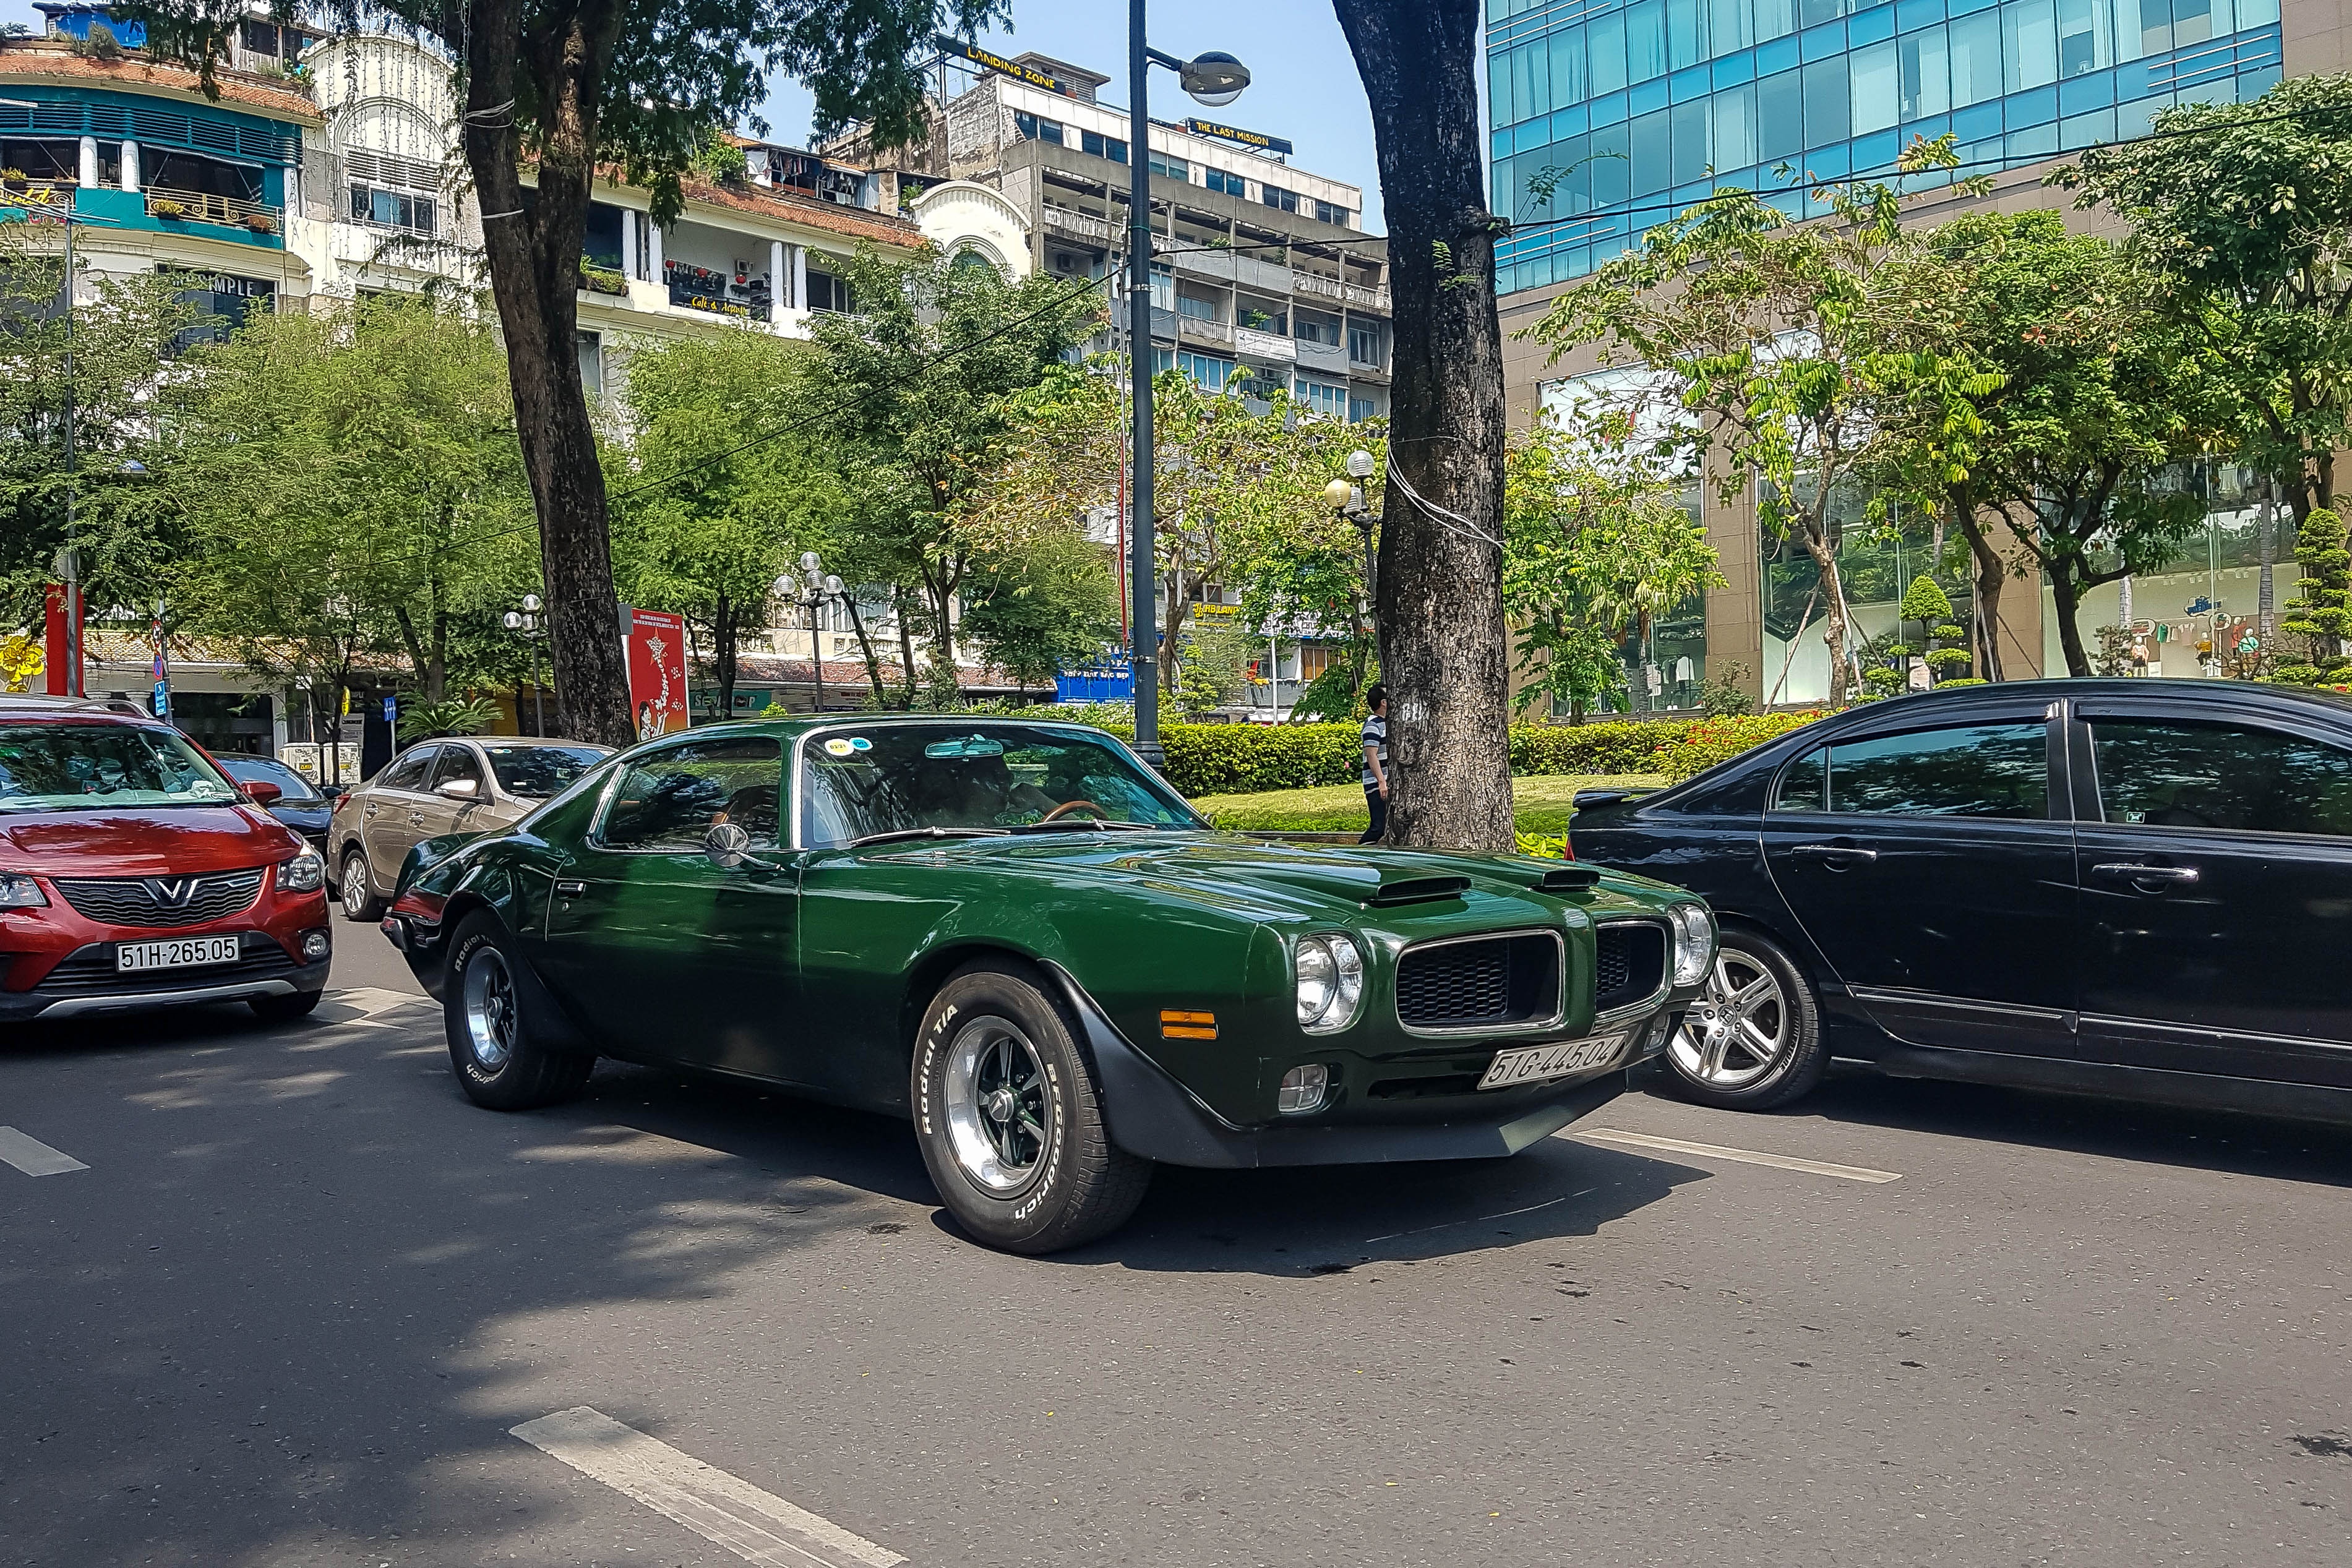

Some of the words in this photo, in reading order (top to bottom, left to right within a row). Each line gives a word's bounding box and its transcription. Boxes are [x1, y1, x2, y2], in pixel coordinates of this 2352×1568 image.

[967, 46, 1021, 75] LANDING
[1024, 69, 1055, 89] ZONE
[1196, 121, 1211, 132] THE
[1213, 126, 1235, 138] LAST
[1237, 131, 1269, 146] MISSION
[121, 938, 236, 968] 51H-265.05
[455, 935, 480, 972] Radial
[1487, 1039, 1618, 1083] 51G-445.04
[919, 1038, 936, 1135] Radial
[1015, 1063, 1064, 1221] BFGoodrich
